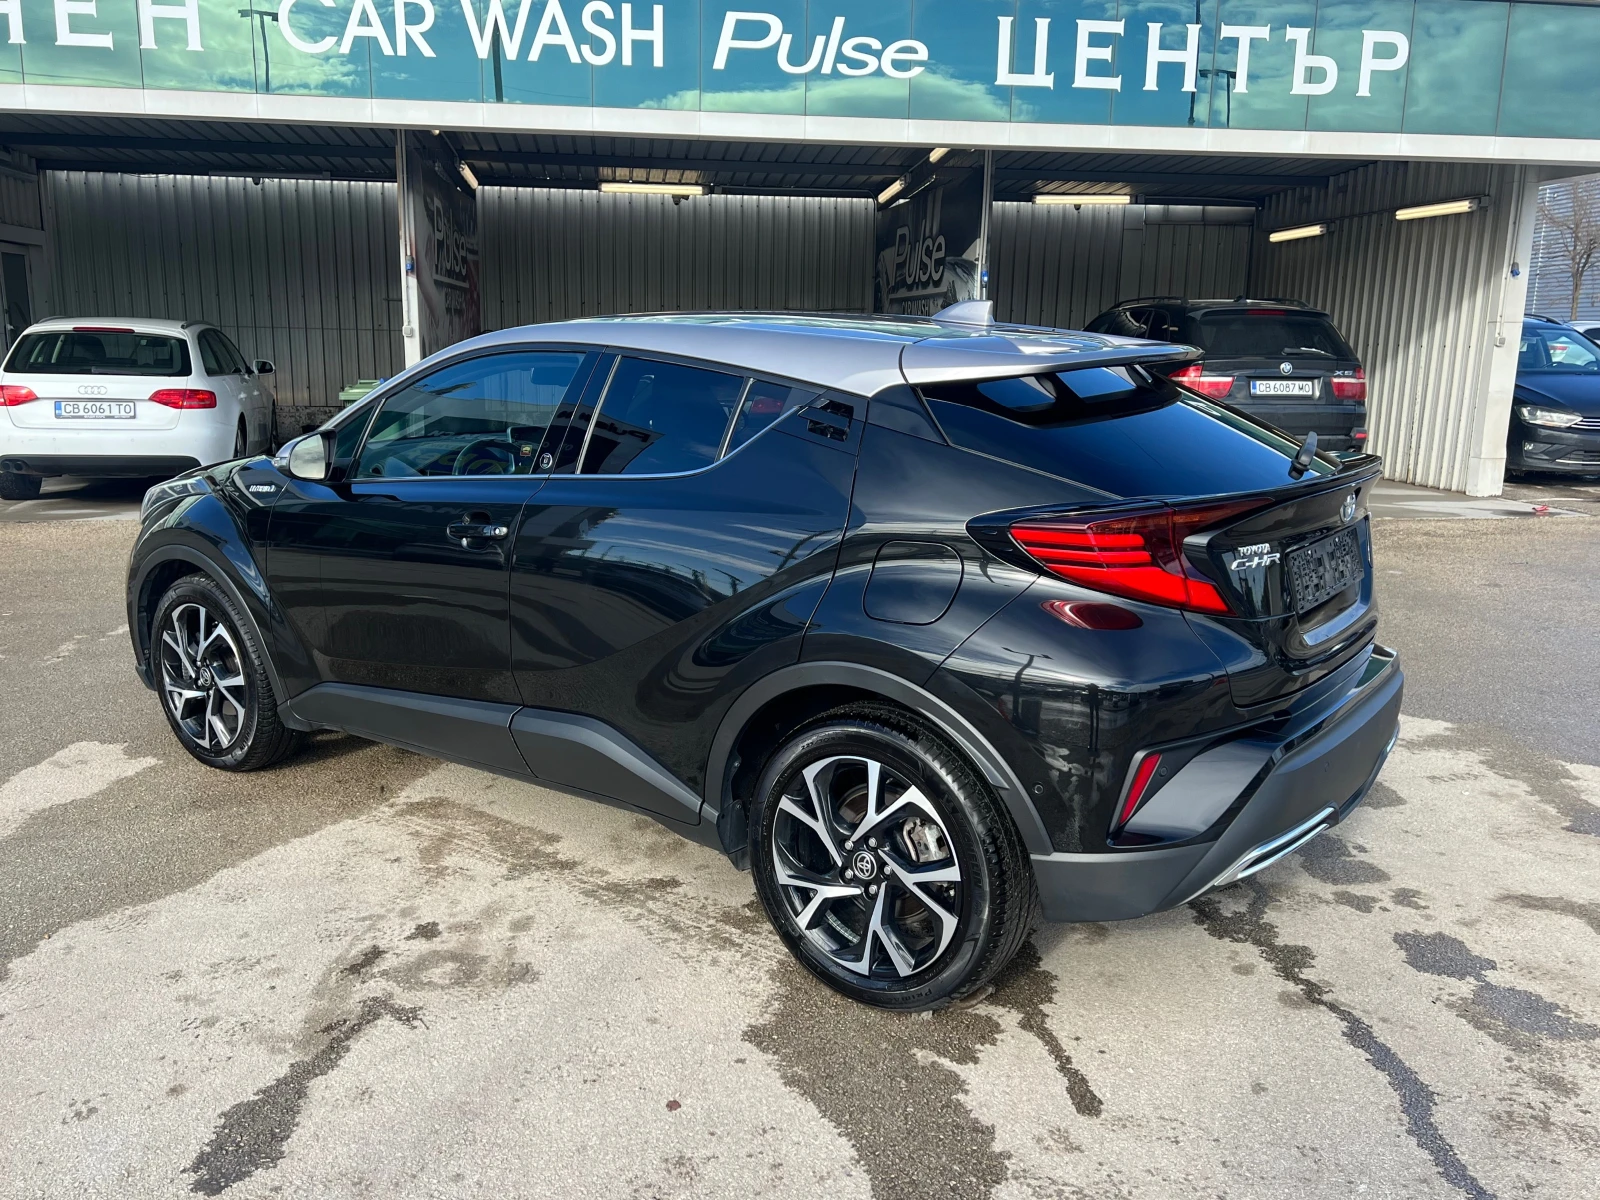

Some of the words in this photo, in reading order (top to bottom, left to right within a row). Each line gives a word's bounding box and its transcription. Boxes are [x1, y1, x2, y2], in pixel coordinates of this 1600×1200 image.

[278, 0, 437, 58] CAR
[467, 0, 664, 68] WASH
[712, 10, 929, 79] Pulse
[994, 16, 1411, 97] ЦЕНТЪР
[433, 198, 467, 277] Pulse
[891, 219, 945, 287] Pulse
[1258, 383, 1271, 393] CB
[1273, 382, 1295, 393] 6087
[63, 404, 81, 415] CB
[83, 404, 113, 415] 6061
[116, 404, 132, 415] TO
[1237, 543, 1271, 557] TOYOTA
[1231, 553, 1281, 571] C-HR
